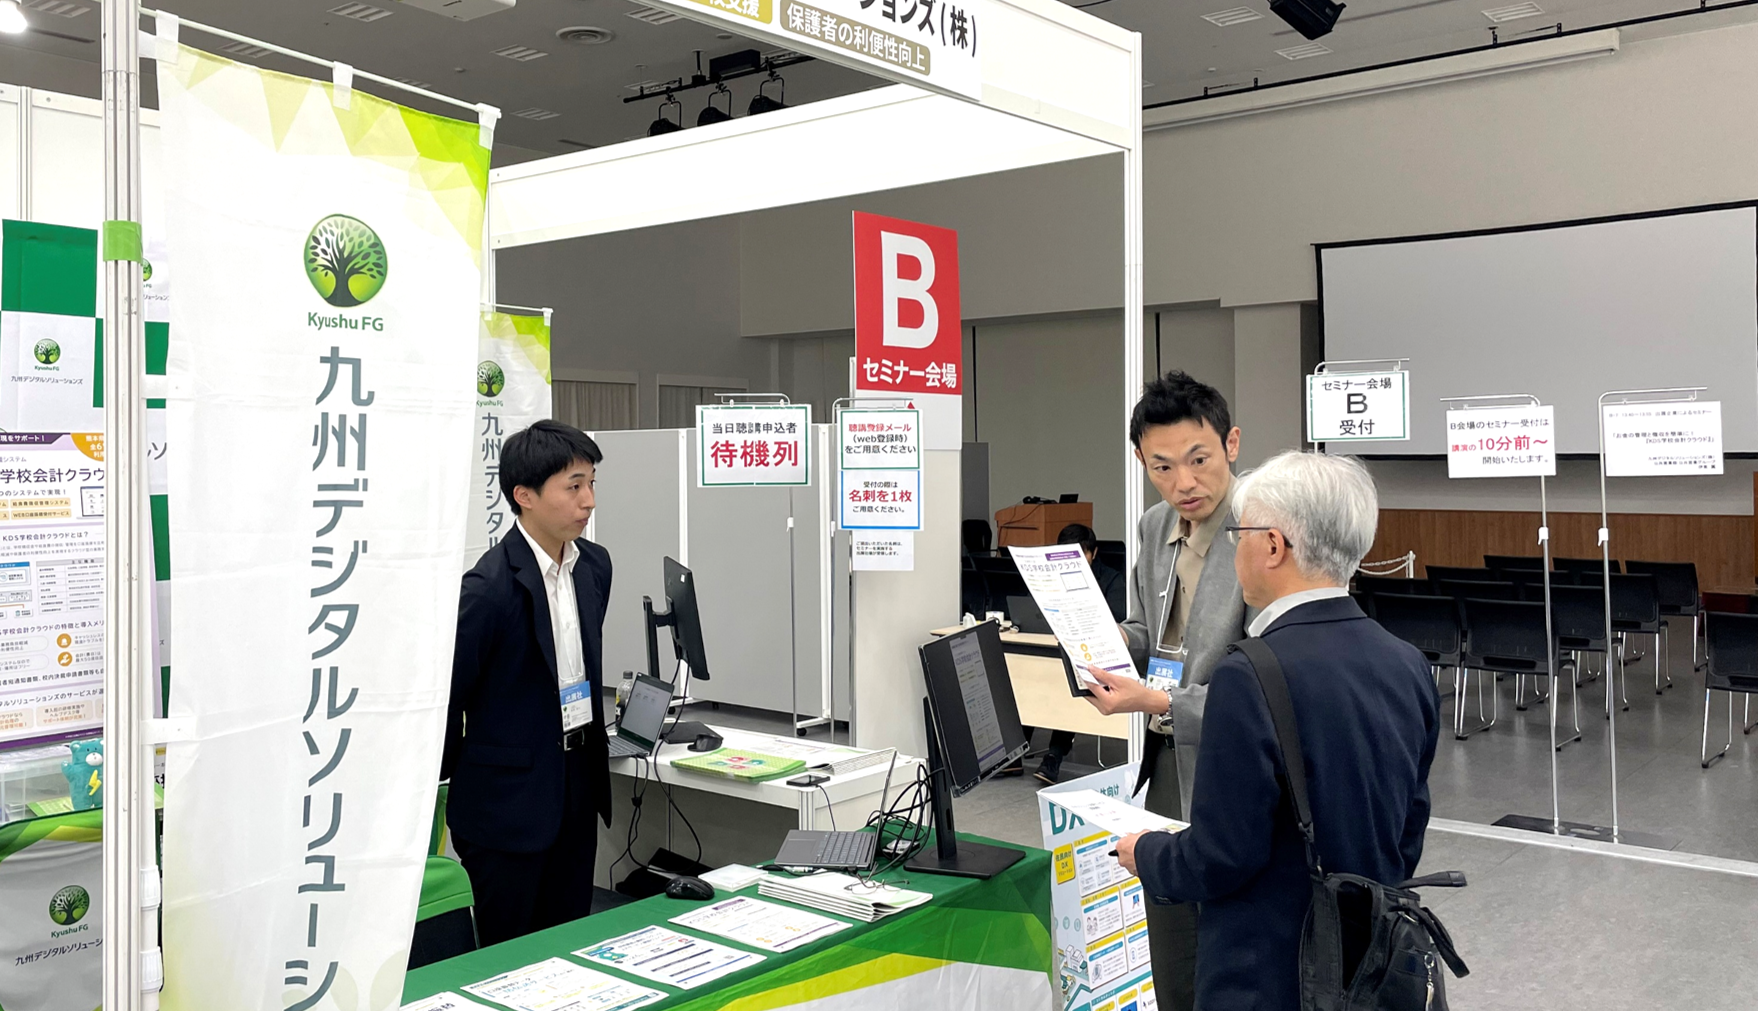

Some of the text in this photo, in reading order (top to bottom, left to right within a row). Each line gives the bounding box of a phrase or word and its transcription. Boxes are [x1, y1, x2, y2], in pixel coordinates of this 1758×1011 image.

[787, 3, 926, 71] 保護者の利便性向上
[881, 230, 939, 349] B
[307, 312, 384, 331] Kyushu FG
[862, 357, 957, 389] セミナー会場
[1322, 377, 1392, 391] セミナー会場
[1347, 393, 1368, 414] B
[712, 422, 798, 434] 当日聴講申込者
[849, 423, 912, 432] 聴講登録メール
[1340, 419, 1375, 435] 受付
[1450, 419, 1549, 430] B会場のセミナー受付は
[852, 434, 908, 443] （web登録時）
[90, 443, 104, 451] 全6
[710, 440, 799, 468] 待機列
[845, 445, 916, 454] をご用意ください
[1482, 455, 1548, 464] 開始いたします。
[0, 468, 104, 483] 学校会計クラウ
[849, 489, 912, 503] 名刺を1枚
[852, 505, 905, 513] ご用意ください。
[284, 346, 375, 1011] 九州デジタルソリューシ
[51, 923, 89, 939] Kyushu FG
